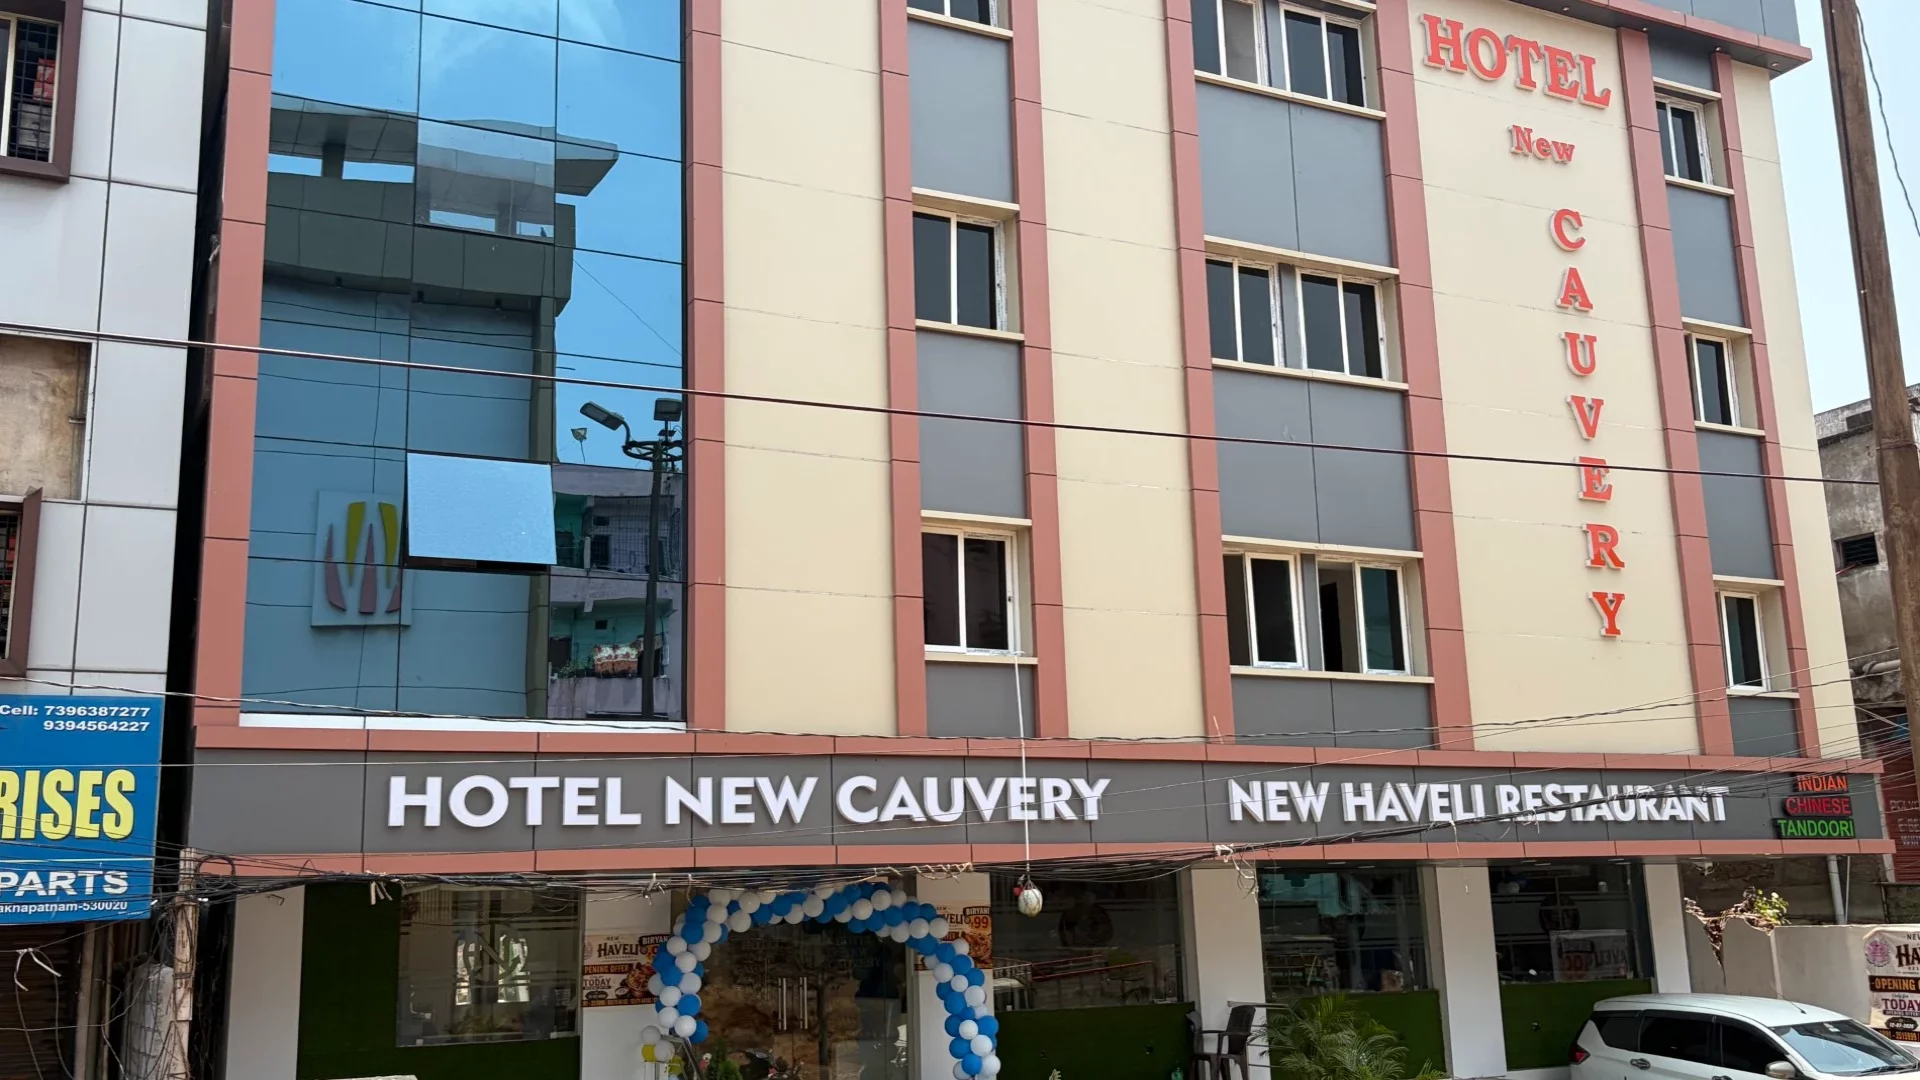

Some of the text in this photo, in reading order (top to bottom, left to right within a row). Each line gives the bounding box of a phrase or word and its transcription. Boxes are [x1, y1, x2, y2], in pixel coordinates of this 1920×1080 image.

[1420, 13, 1612, 108] HOTEL
[1509, 124, 1575, 164] New
[1549, 208, 1625, 638] CAUVERY
[0, 705, 150, 717] Cell: 7396387277
[43, 720, 150, 732] 9394564227
[1797, 775, 1847, 792] INDIAN
[0, 768, 136, 840] RISES
[388, 775, 1111, 828] HOTEL NEW CAUVERY
[1228, 779, 1729, 822] NEW HAVELI RESTAURANT
[1785, 796, 1852, 814] CHINESE
[1777, 820, 1855, 837] TANDOORI
[0, 870, 128, 896] PARTS
[597, 943, 639, 957] HAVELI
[583, 978, 611, 987] TODAY
[1875, 978, 1916, 990] OPENING
